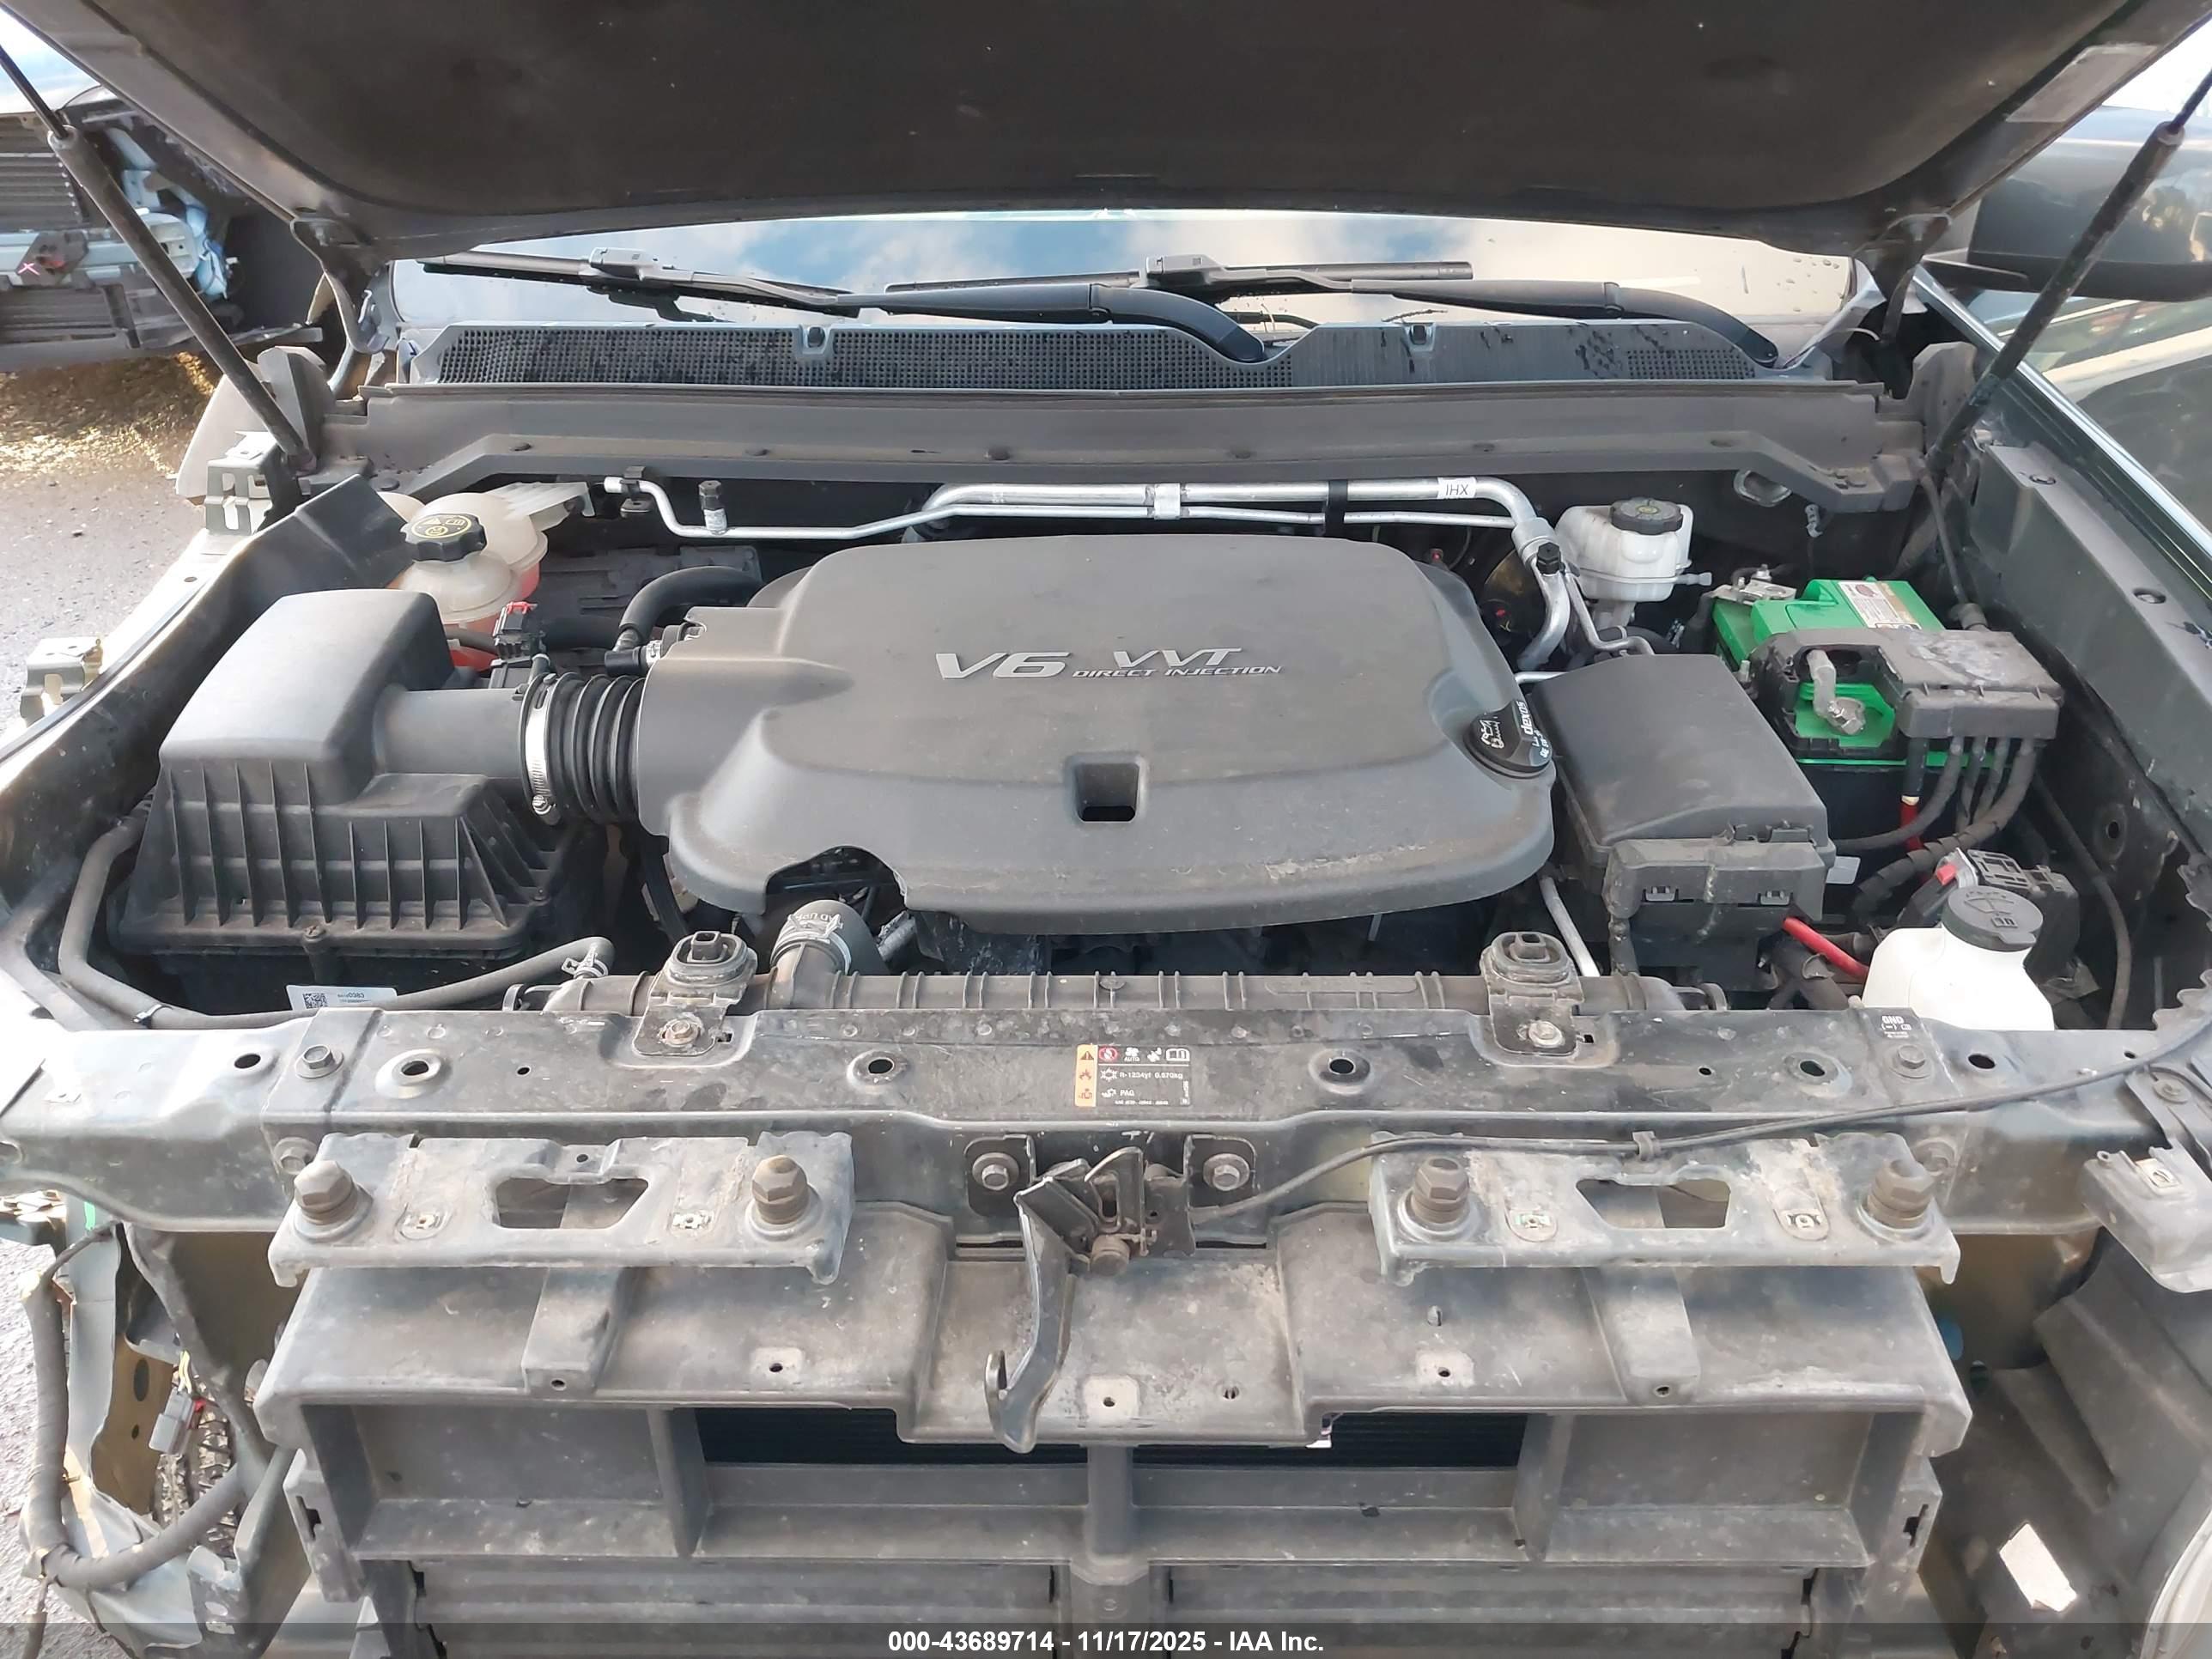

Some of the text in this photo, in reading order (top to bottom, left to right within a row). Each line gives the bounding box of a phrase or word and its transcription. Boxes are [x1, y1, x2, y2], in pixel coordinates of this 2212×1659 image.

[1446, 483, 1469, 495] IHX
[935, 652, 1072, 680] V6
[1113, 647, 1243, 669] VVT
[1073, 665, 1283, 678] DIRECT INJECTION
[1516, 701, 1533, 735] dexos
[1881, 1015, 1905, 1024] GND
